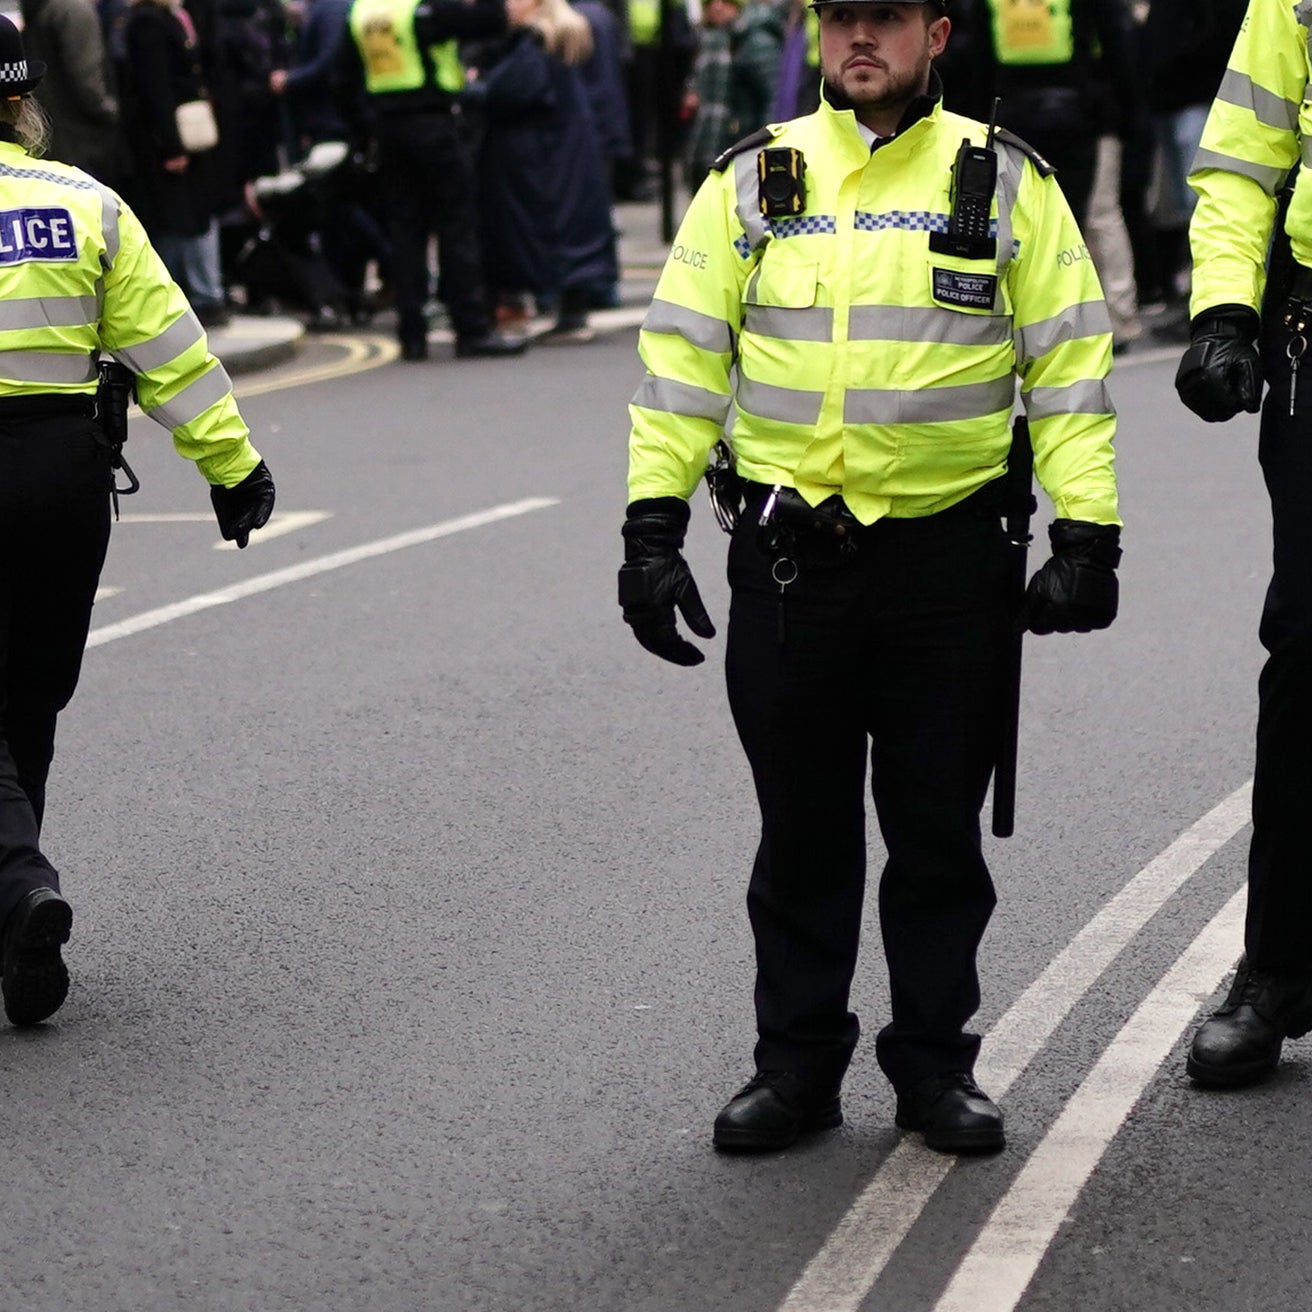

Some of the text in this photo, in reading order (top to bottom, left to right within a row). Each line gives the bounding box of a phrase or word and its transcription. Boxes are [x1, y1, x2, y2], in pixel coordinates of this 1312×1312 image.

[958, 282, 984, 292] POLICE
[936, 288, 991, 304] POLICE OFFICER
